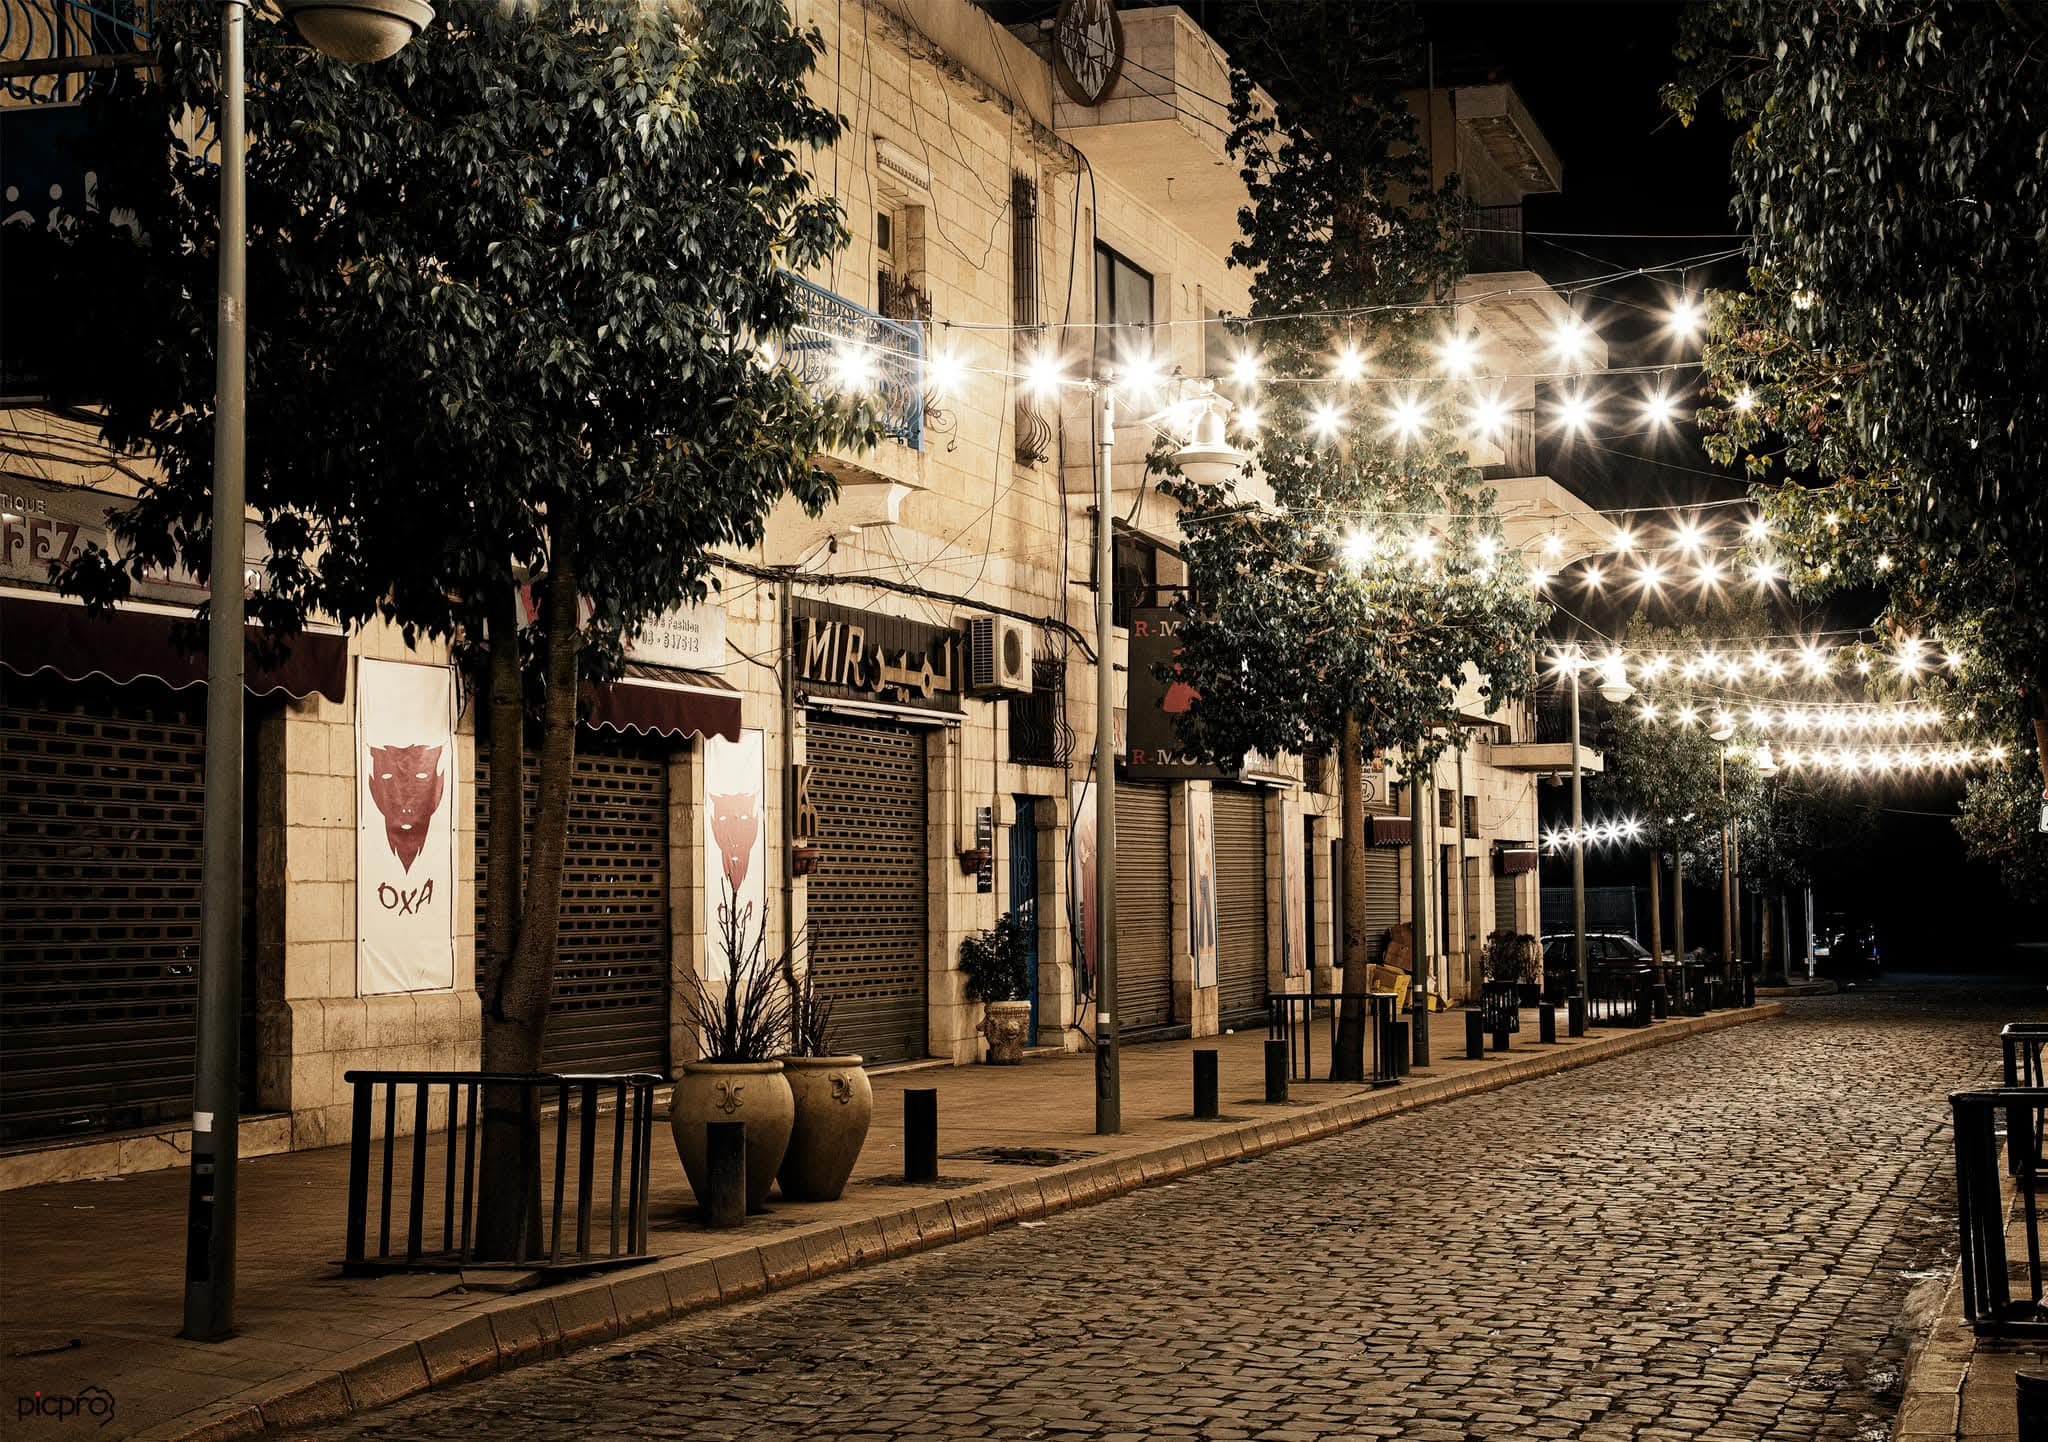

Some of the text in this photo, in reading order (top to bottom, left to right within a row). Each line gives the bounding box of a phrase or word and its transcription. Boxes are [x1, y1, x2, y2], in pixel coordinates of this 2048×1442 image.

[667, 616, 700, 633] Fashion
[801, 616, 866, 688] MIR
[377, 877, 434, 917] OXA
